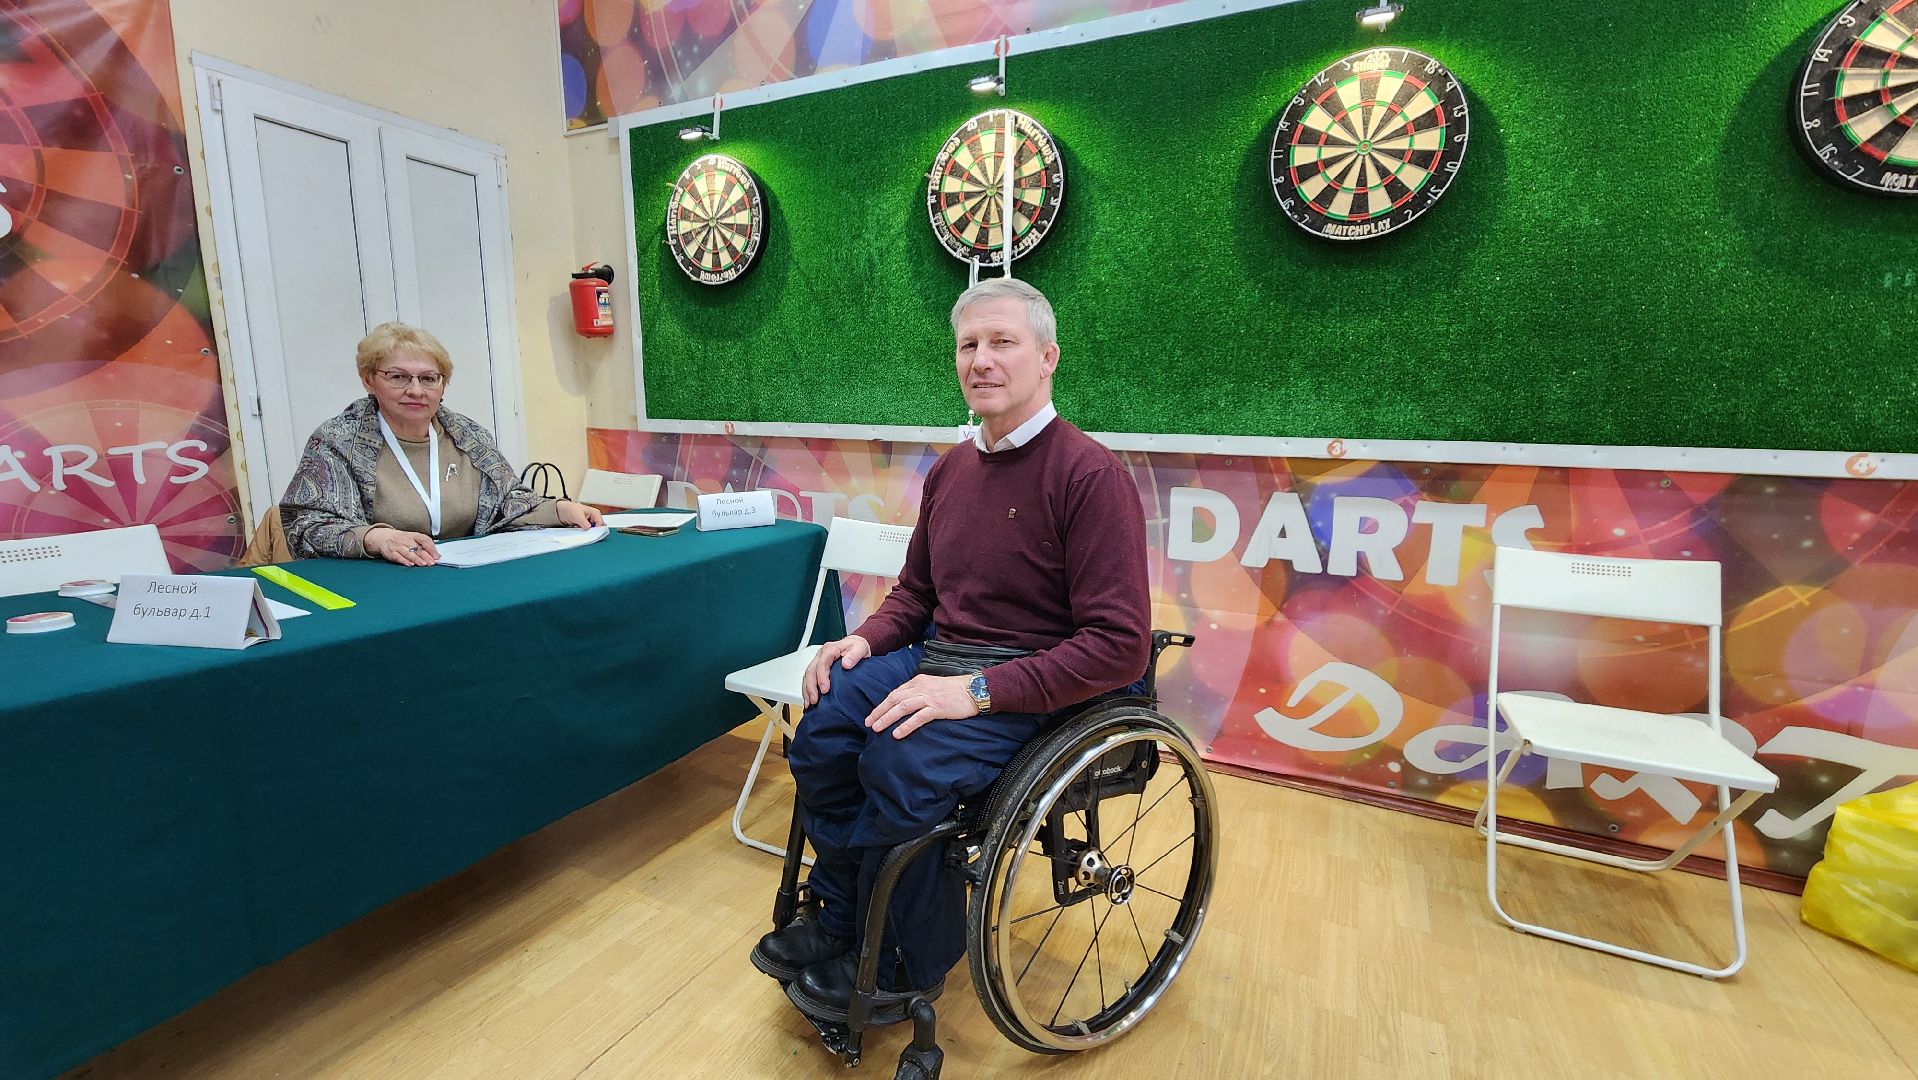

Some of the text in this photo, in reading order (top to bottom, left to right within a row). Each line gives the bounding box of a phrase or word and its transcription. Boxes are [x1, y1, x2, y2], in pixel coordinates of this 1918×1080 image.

[1838, 15, 1856, 27] 9
[1812, 49, 1833, 63] 14
[1424, 58, 1439, 74] 18
[1313, 73, 1330, 87] 12
[1446, 81, 1456, 92] 4
[1801, 83, 1821, 96] 11
[1293, 96, 1305, 106] 9
[1805, 118, 1821, 130] 8
[1818, 143, 1838, 161] 16
[1849, 164, 1865, 180] 7
[1325, 217, 1391, 237] MATCHPLAY
[147, 581, 199, 595] Лесной
[133, 603, 211, 620] бульвар д.1
